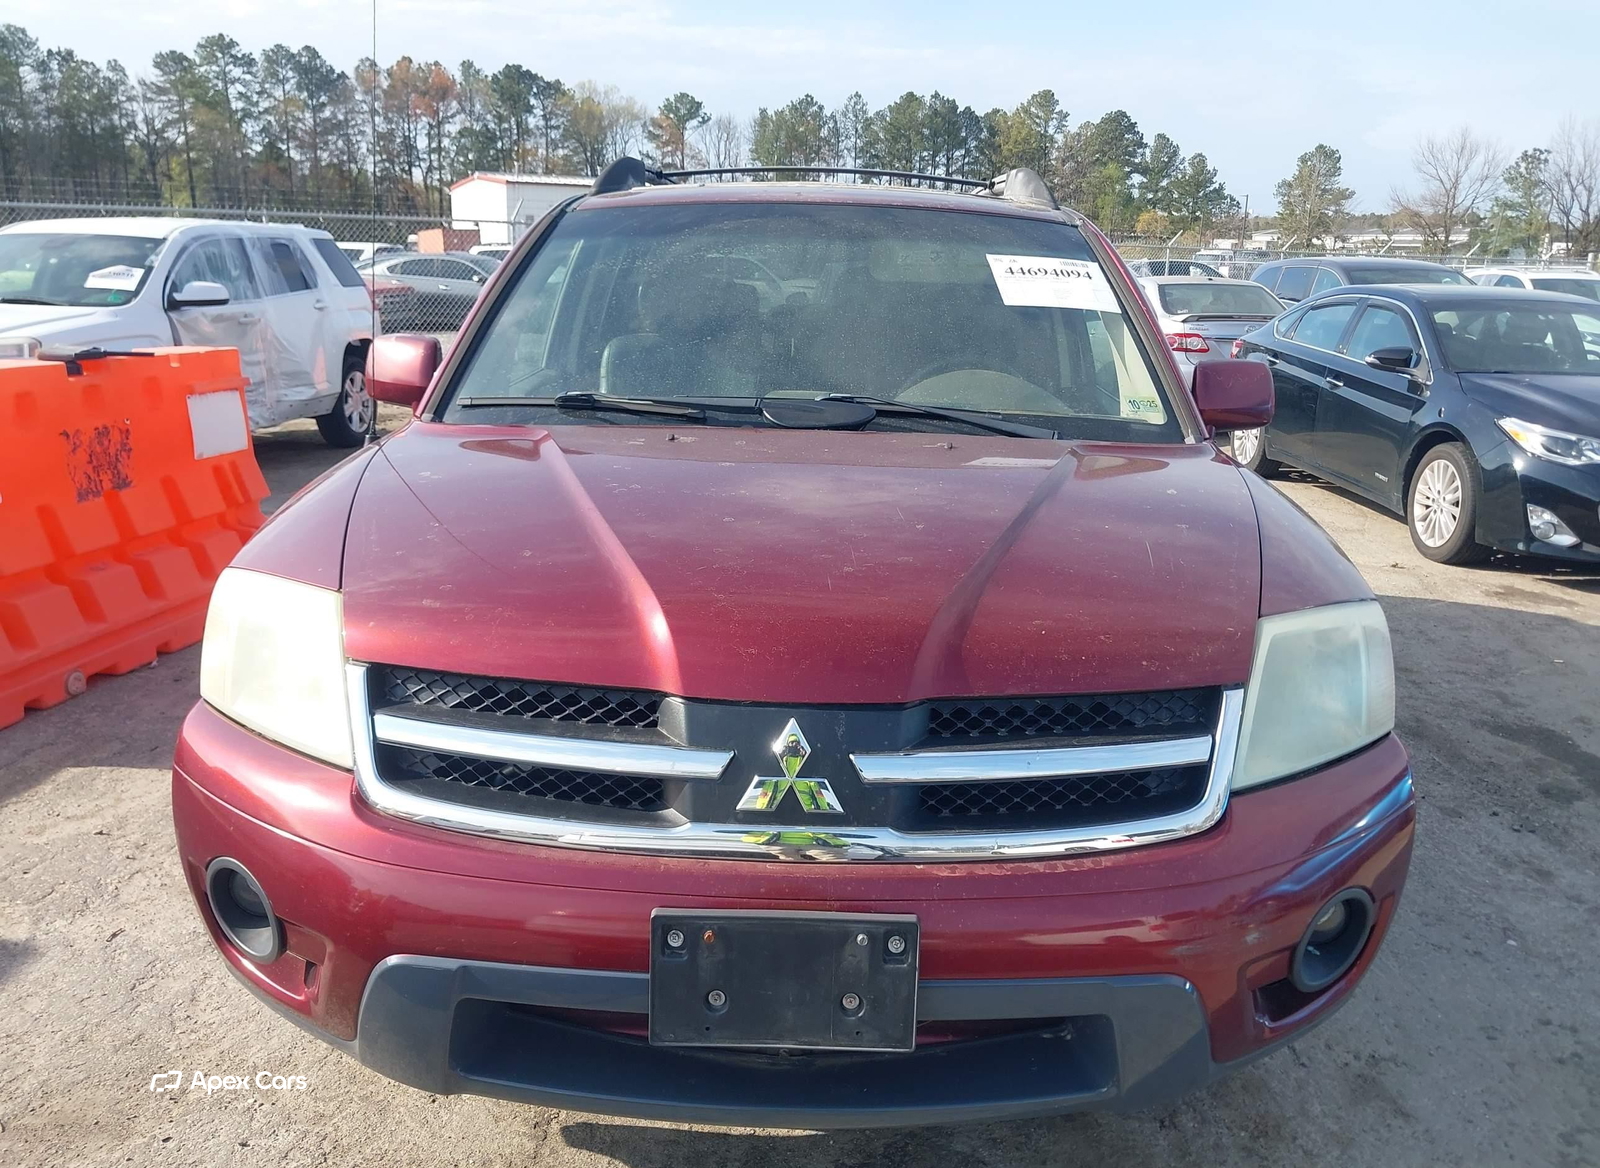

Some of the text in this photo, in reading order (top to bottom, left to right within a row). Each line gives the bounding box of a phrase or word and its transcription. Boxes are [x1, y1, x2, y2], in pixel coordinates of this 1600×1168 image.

[1004, 266, 1093, 280] 44694094
[1128, 399, 1158, 410] 10 25
